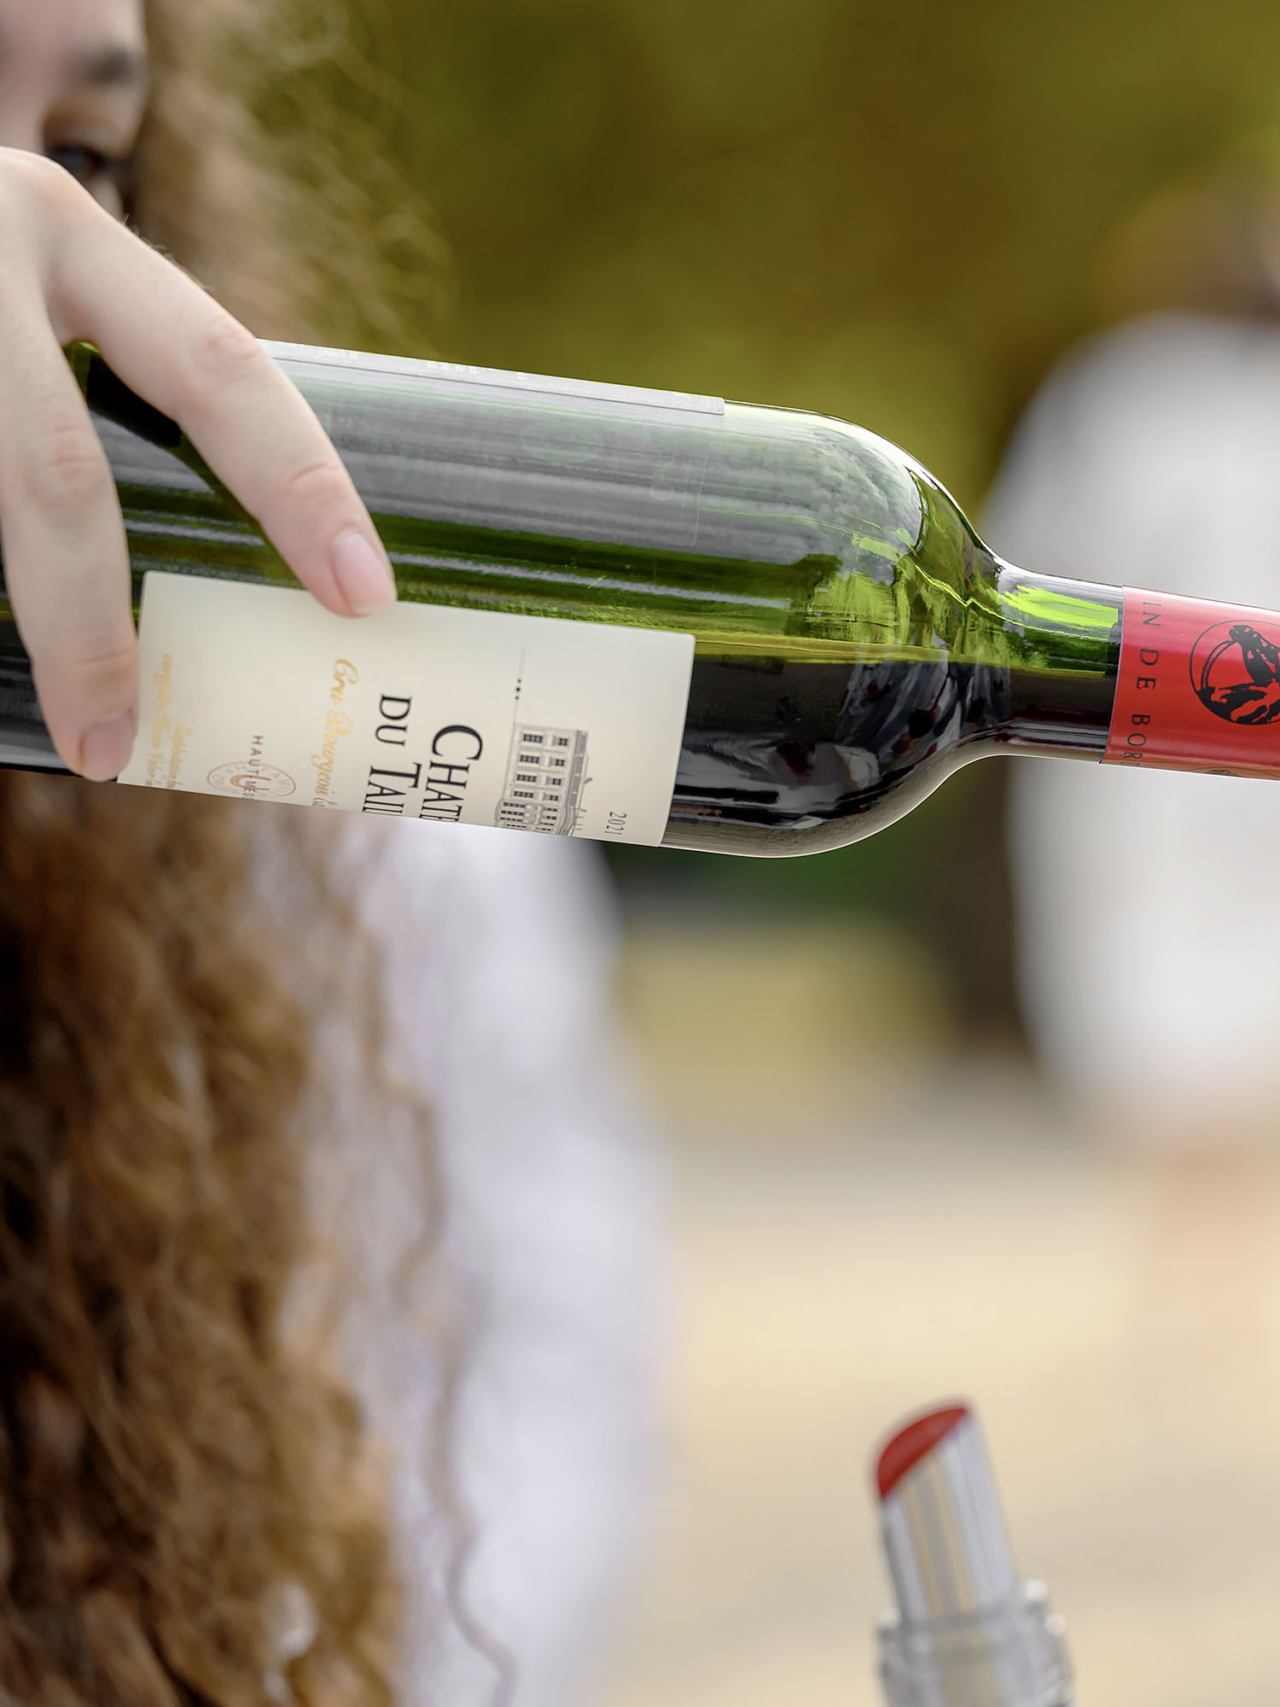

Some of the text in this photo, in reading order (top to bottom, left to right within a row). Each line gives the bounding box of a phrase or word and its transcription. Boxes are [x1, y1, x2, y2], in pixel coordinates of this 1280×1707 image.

[330, 658, 360, 703] Cru
[1135, 648, 1159, 691] DE
[310, 708, 352, 797] Bourgeois
[362, 694, 422, 817] DU TAIL
[604, 811, 628, 836] 2021
